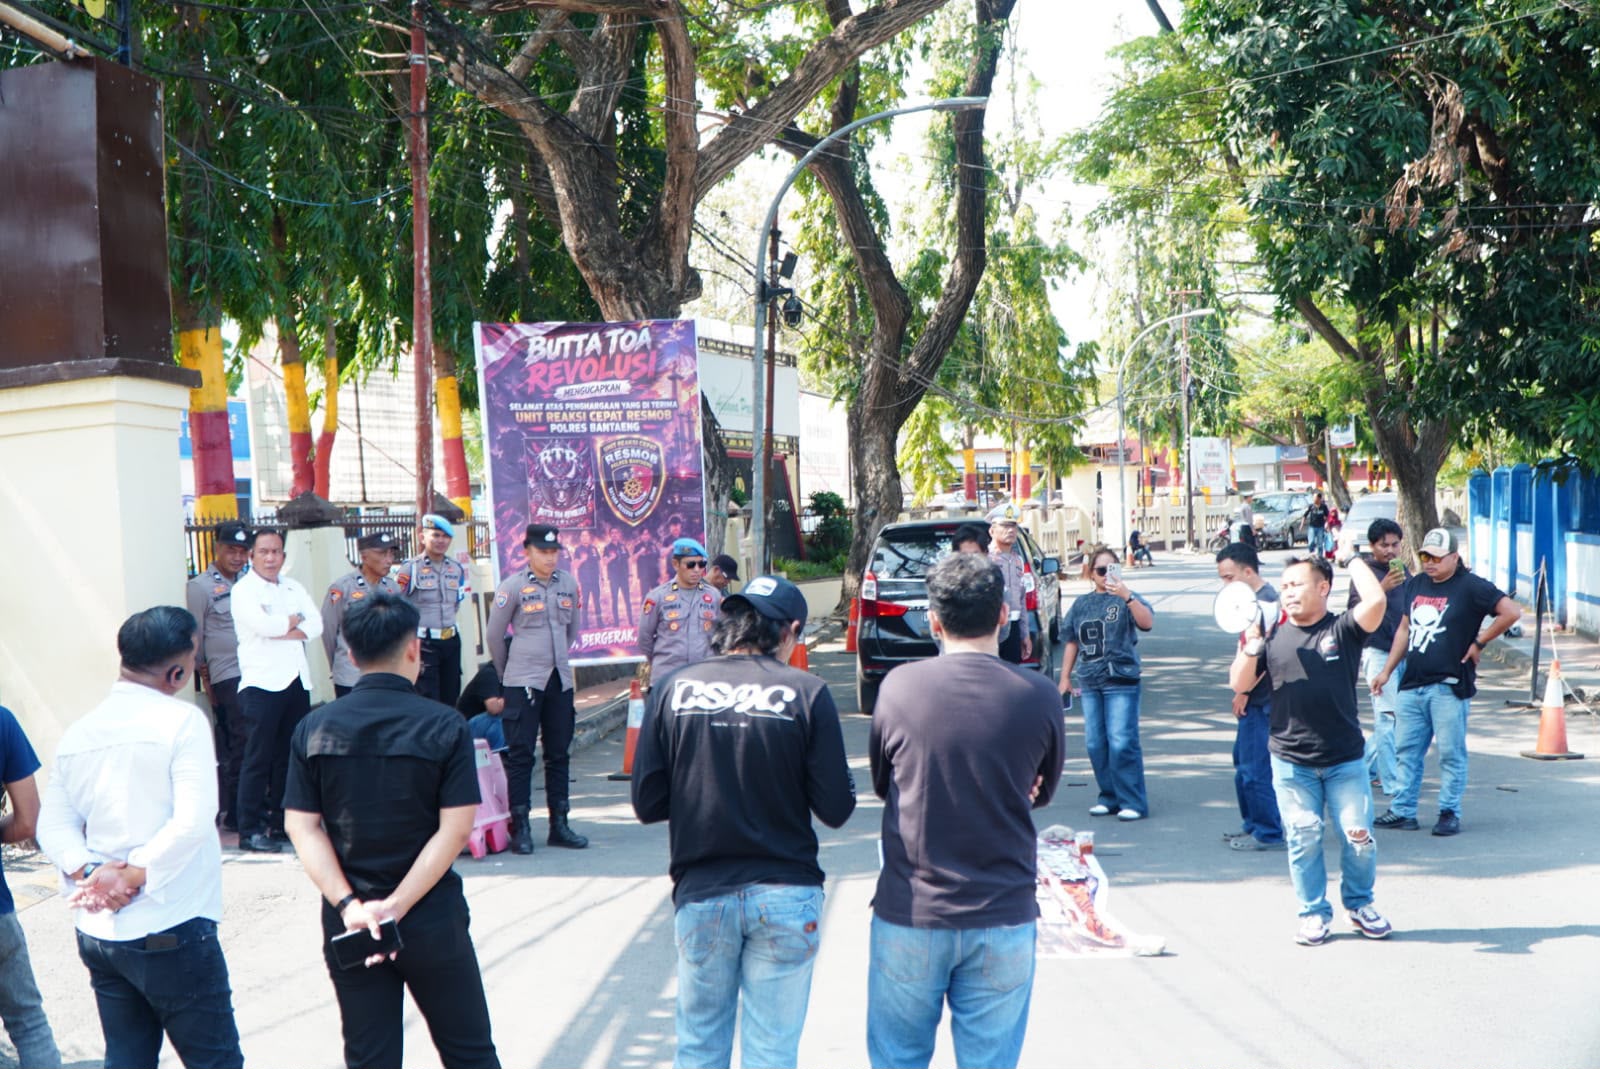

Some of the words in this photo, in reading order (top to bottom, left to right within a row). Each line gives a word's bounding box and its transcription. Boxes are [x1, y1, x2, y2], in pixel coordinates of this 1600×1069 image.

[525, 331, 602, 367] BUTTA
[605, 327, 652, 359] TOA
[527, 351, 657, 394] REVOLUSI
[564, 384, 621, 397] MENGUCAPKAN
[509, 402, 543, 411] SELAMAT
[545, 402, 563, 411] ATAS
[565, 402, 620, 411] PENGHARGAAN
[622, 401, 640, 410] YANG
[642, 401, 650, 409] DI
[651, 400, 678, 409] TERIMA
[515, 411, 543, 424] UNIT
[547, 410, 587, 423] REAKSI
[589, 410, 623, 422] CEPAT
[626, 409, 673, 421] RESMOB
[550, 423, 587, 433] POLRES
[589, 422, 641, 433] BANTAENG
[605, 448, 658, 465] RESMOB
[1105, 604, 1119, 622] 3
[581, 628, 638, 648] BERGERAK,
[1079, 618, 1105, 663] 9
